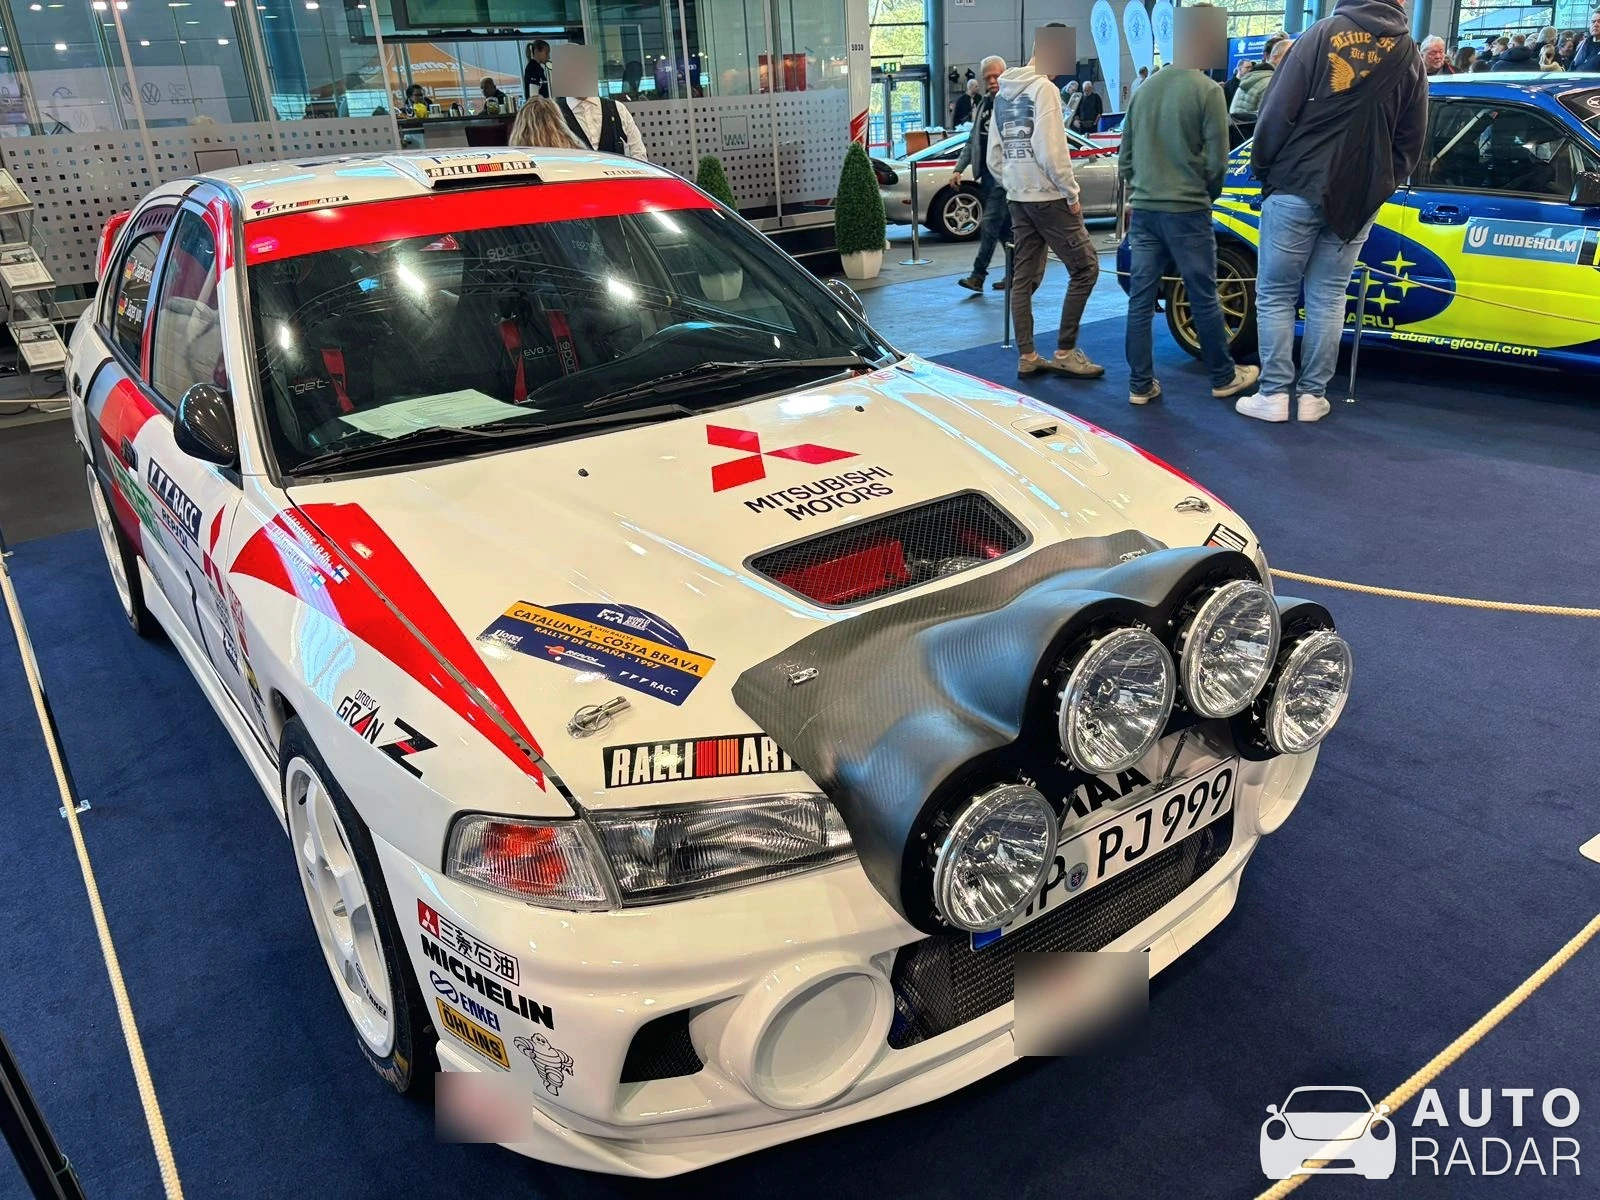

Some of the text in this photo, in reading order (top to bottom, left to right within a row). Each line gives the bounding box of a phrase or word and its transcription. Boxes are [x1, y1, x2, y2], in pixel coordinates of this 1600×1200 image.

[486, 241, 541, 262] sparco
[1493, 233, 1577, 253] UDDEHOLM
[1298, 308, 1394, 329] SARU
[523, 346, 544, 357] EVO
[1391, 331, 1538, 358] subaru-global.com
[172, 487, 197, 533] RACC
[744, 466, 893, 514] MITSUBISHI
[784, 482, 894, 521] MOTORS
[513, 609, 592, 639] CATALUNYA
[603, 636, 647, 655] COSTA
[649, 650, 700, 673] BRAVA
[534, 626, 570, 643] RALLYE
[571, 635, 586, 646] DE
[586, 641, 626, 660] ESPAÑA
[633, 656, 662, 669] 1997
[354, 689, 377, 711] ORBIS
[650, 681, 679, 696] RACC
[610, 741, 694, 787] RALLI
[1097, 808, 1153, 879] PJ
[1162, 768, 1232, 843] 999
[440, 919, 515, 980] 三菱石油
[421, 934, 555, 1030] MICHELIN
[442, 1003, 504, 1061] ÖHLINS
[459, 991, 501, 1032] ENKEI
